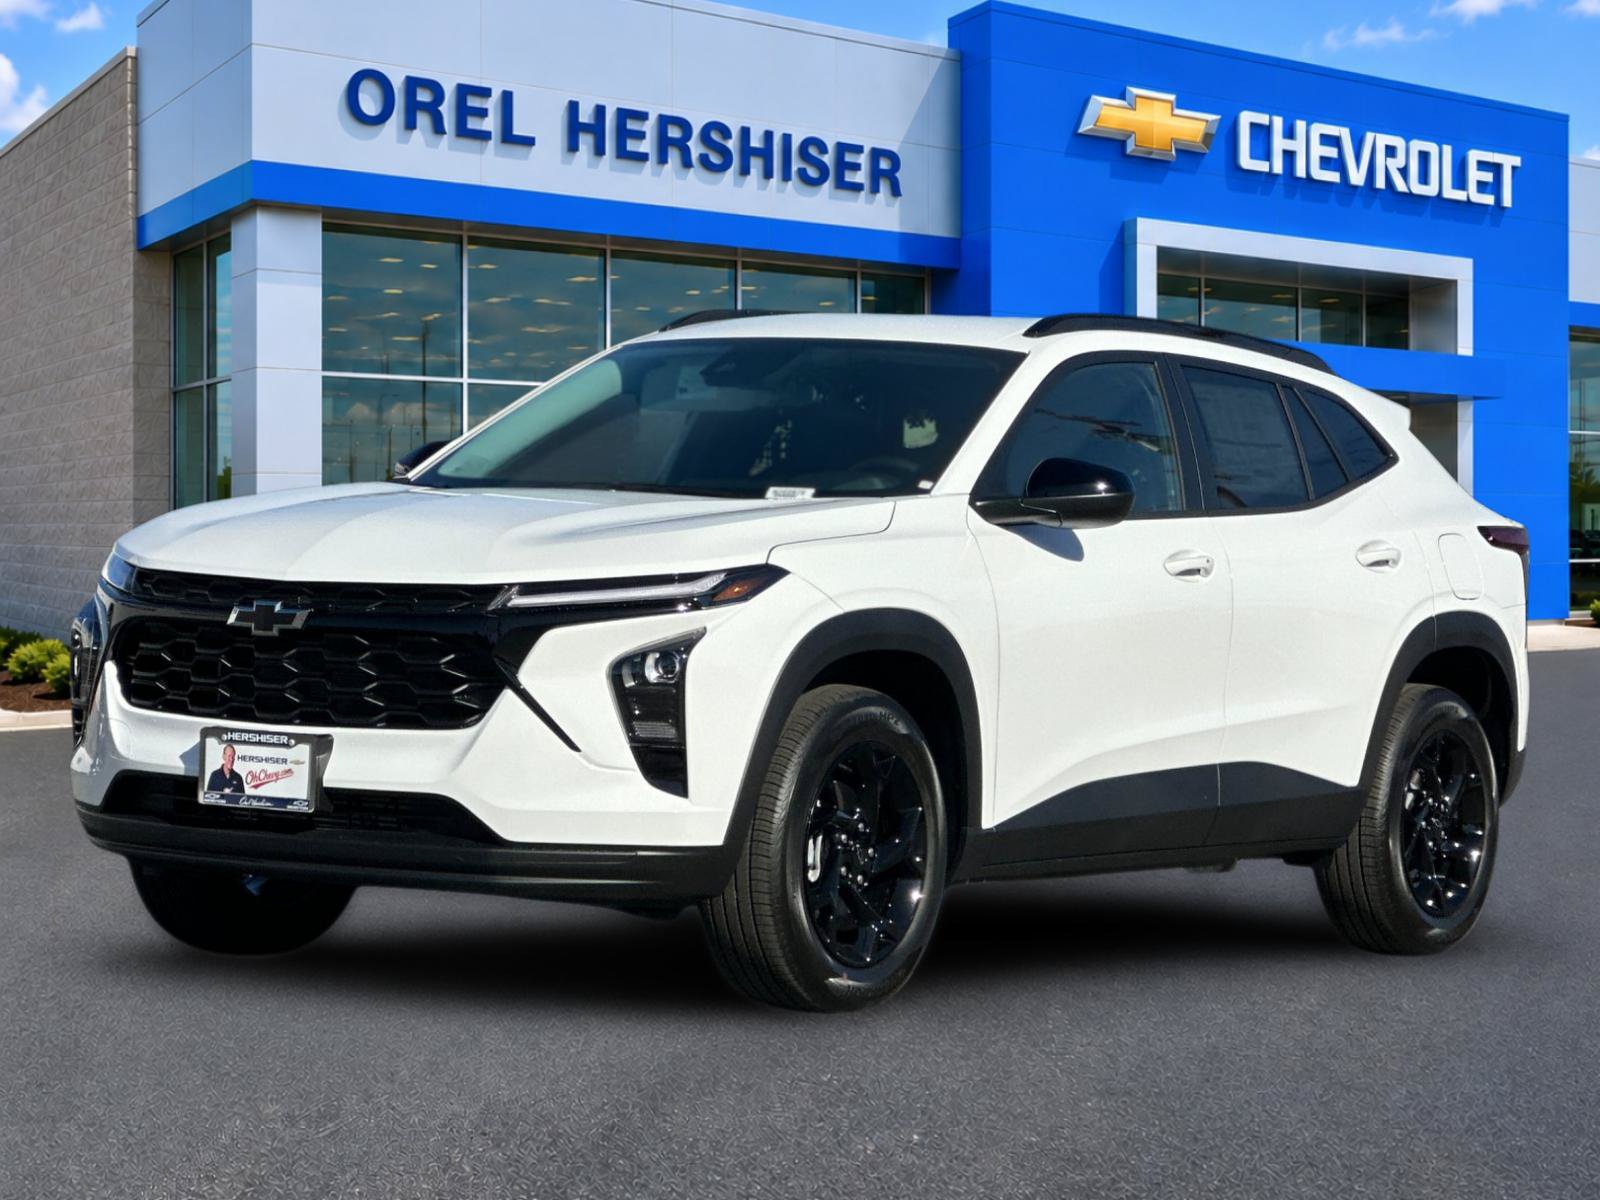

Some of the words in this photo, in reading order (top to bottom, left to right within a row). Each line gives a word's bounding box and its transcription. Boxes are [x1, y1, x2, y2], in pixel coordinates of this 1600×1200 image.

[346, 68, 536, 147] OREL
[566, 99, 903, 198] HERSHISER
[1236, 109, 1522, 208] CHEVROLET
[227, 731, 289, 744] HERSHISER
[237, 754, 288, 765] HERSHISER
